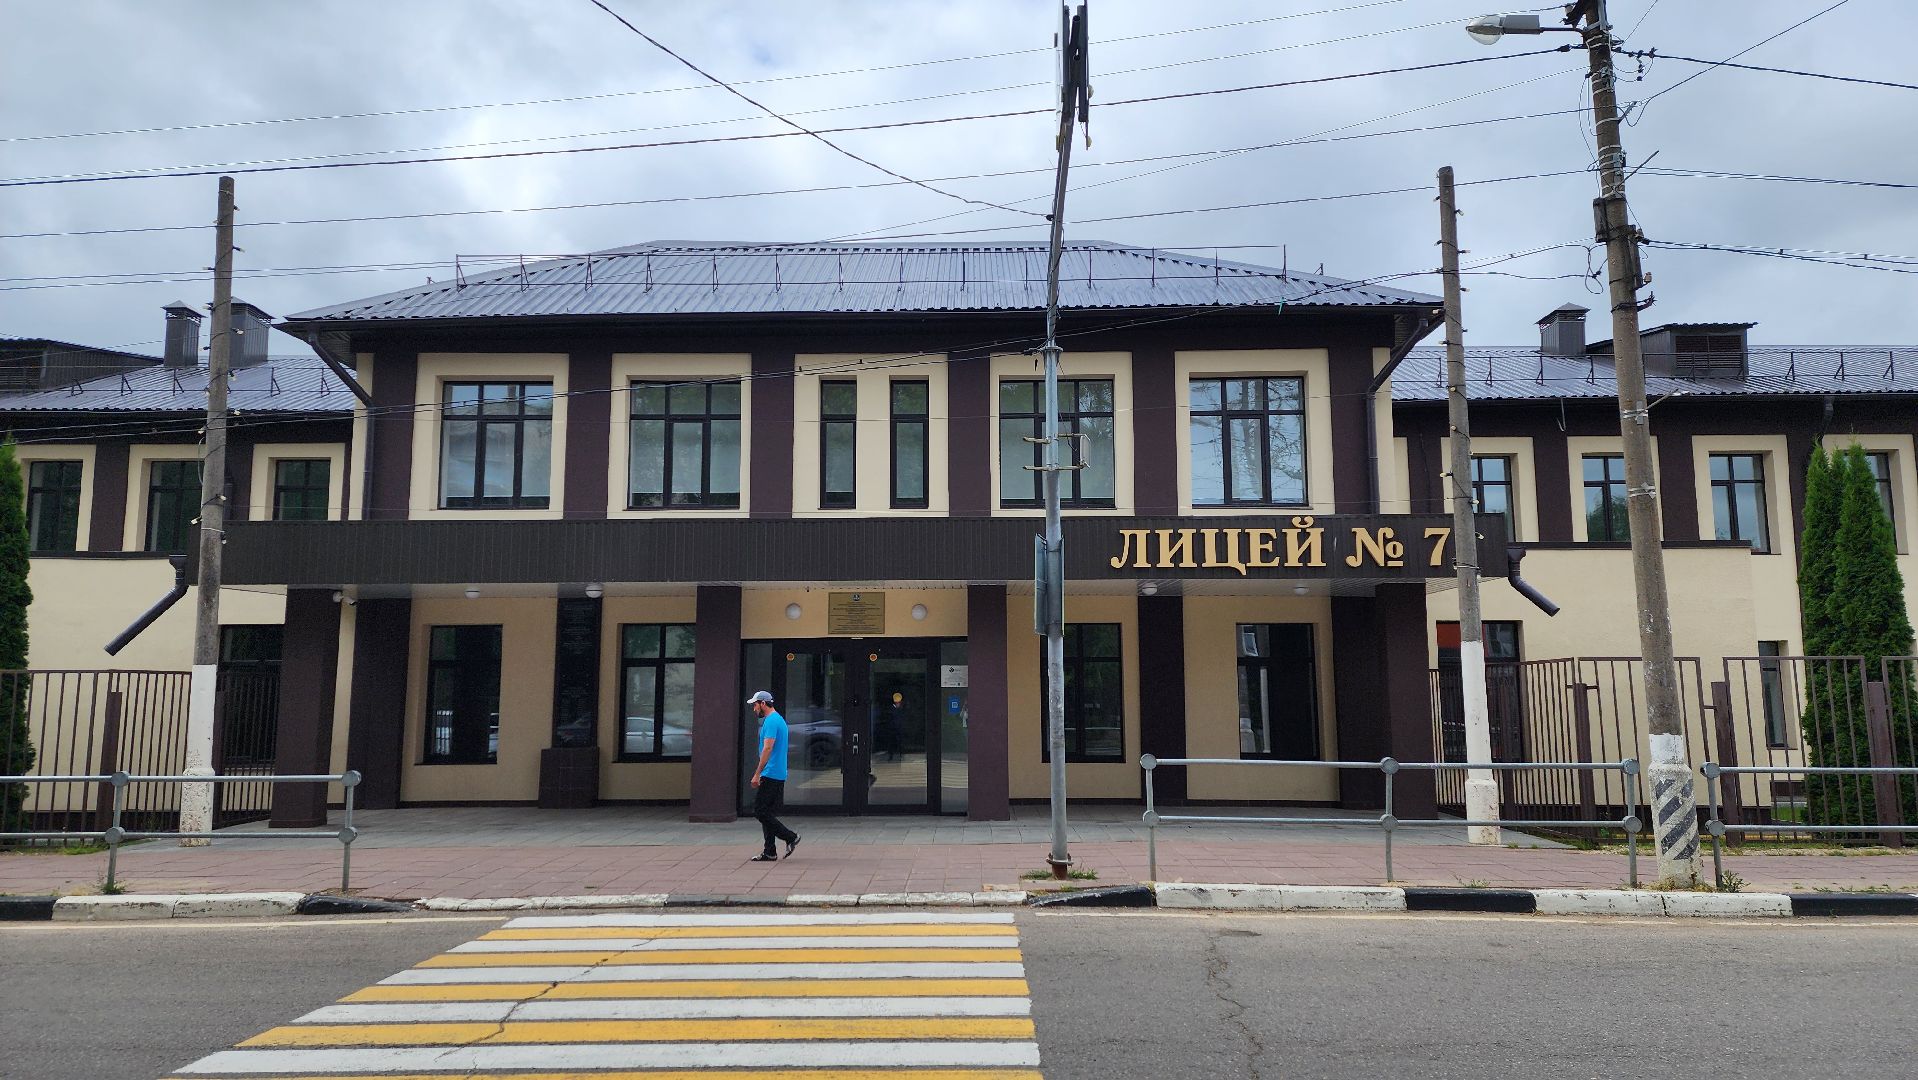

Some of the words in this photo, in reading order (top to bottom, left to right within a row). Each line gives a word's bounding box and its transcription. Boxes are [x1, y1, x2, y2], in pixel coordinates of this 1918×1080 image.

[1110, 516, 1325, 576] ЛИЦЕЙ
[1345, 527, 1404, 567] №
[1424, 527, 1451, 567] 7
